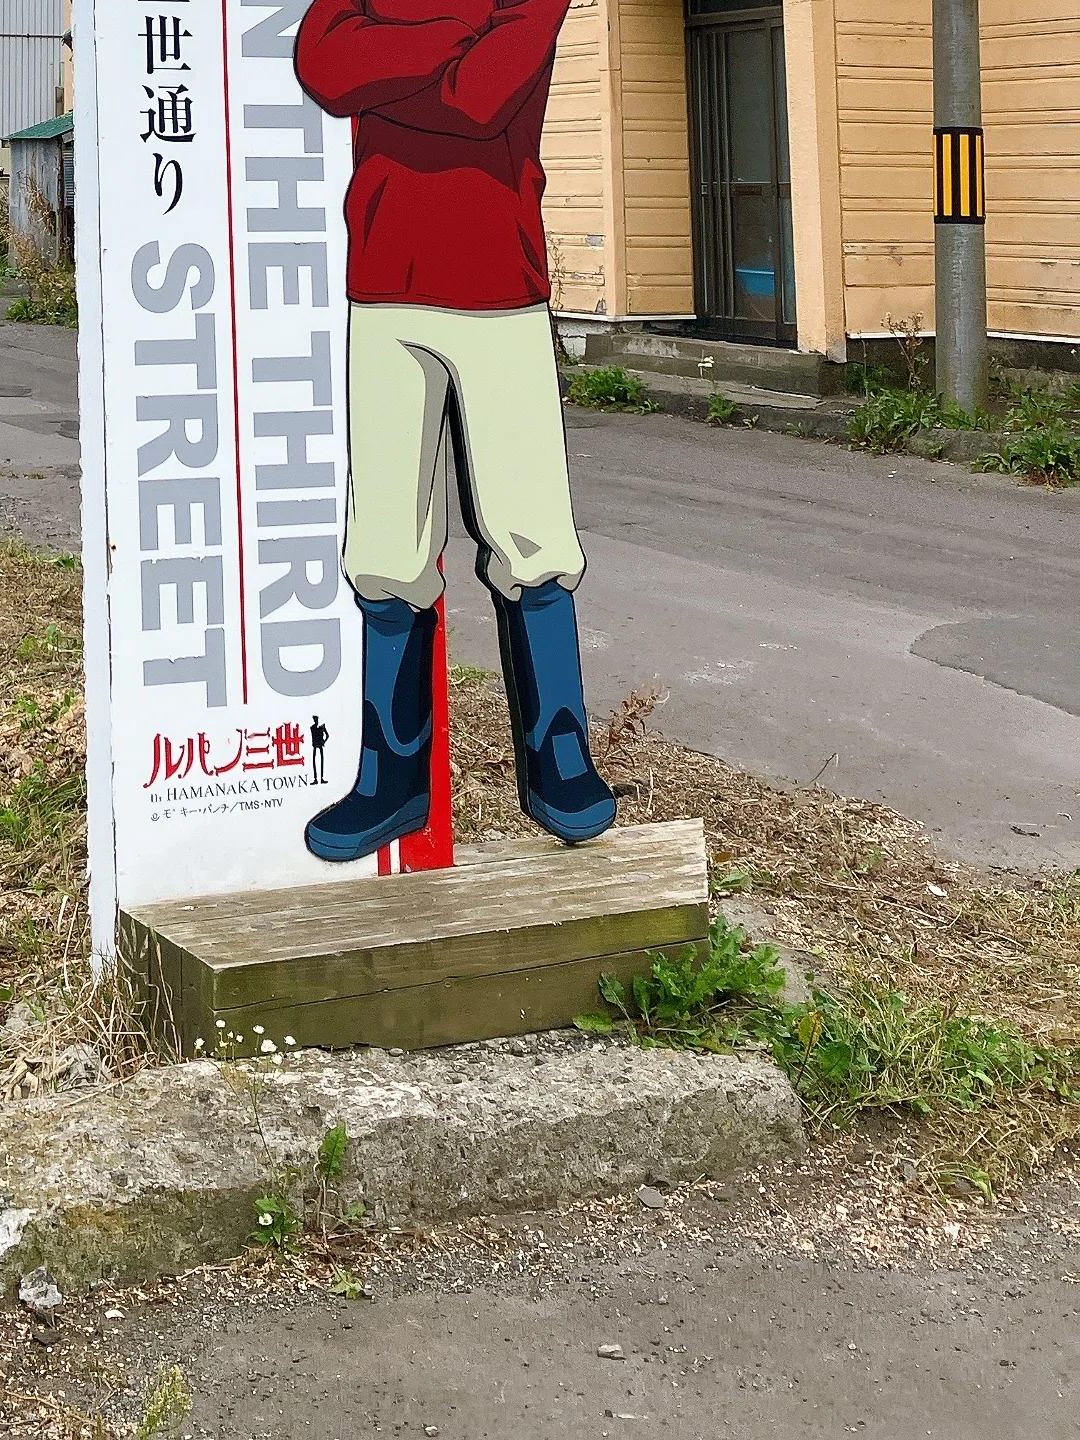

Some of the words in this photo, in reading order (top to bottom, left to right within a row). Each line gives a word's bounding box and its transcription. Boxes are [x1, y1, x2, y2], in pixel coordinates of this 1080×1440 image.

[243, 103, 329, 310] THE
[131, 240, 228, 708] STREET
[251, 331, 343, 698] THIRD
[166, 780, 259, 802] HAMANAKA
[263, 774, 308, 791] TOWN
